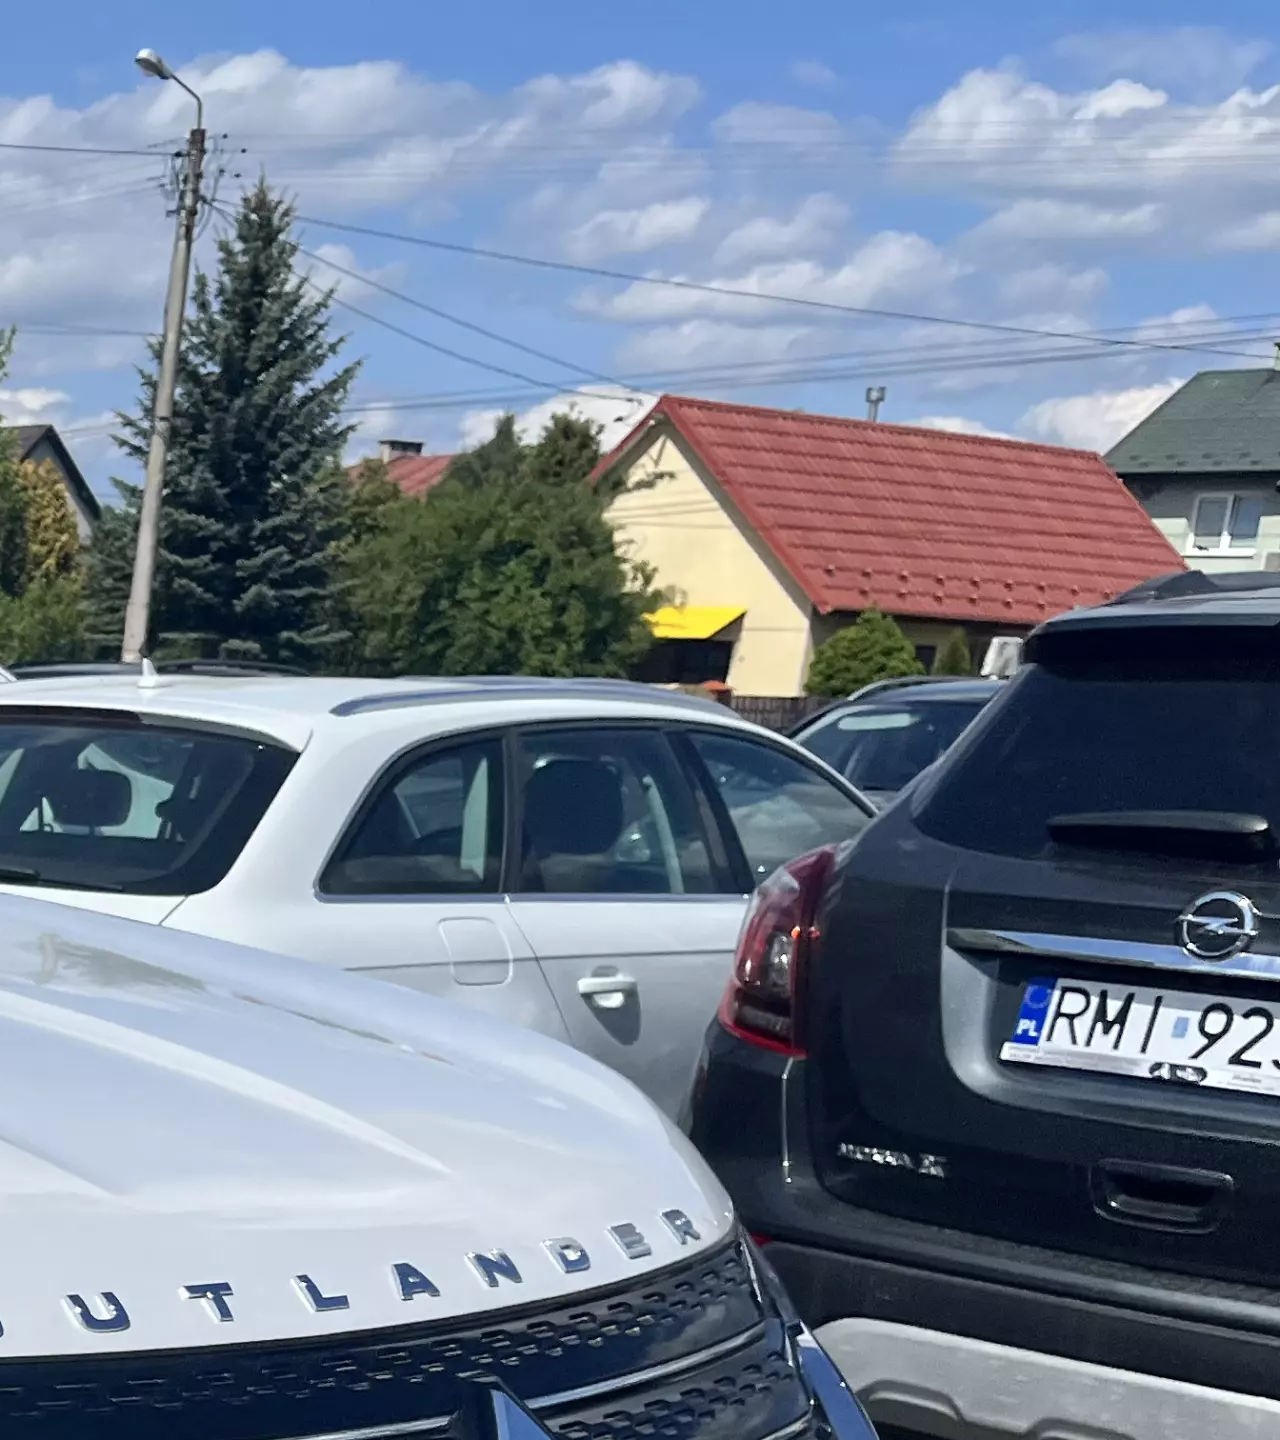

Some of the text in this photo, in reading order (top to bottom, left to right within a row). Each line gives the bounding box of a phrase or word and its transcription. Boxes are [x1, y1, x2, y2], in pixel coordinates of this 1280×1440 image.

[1015, 1018, 1039, 1037] PL
[1046, 985, 1164, 1054] RMI
[1189, 1002, 1280, 1071] 92
